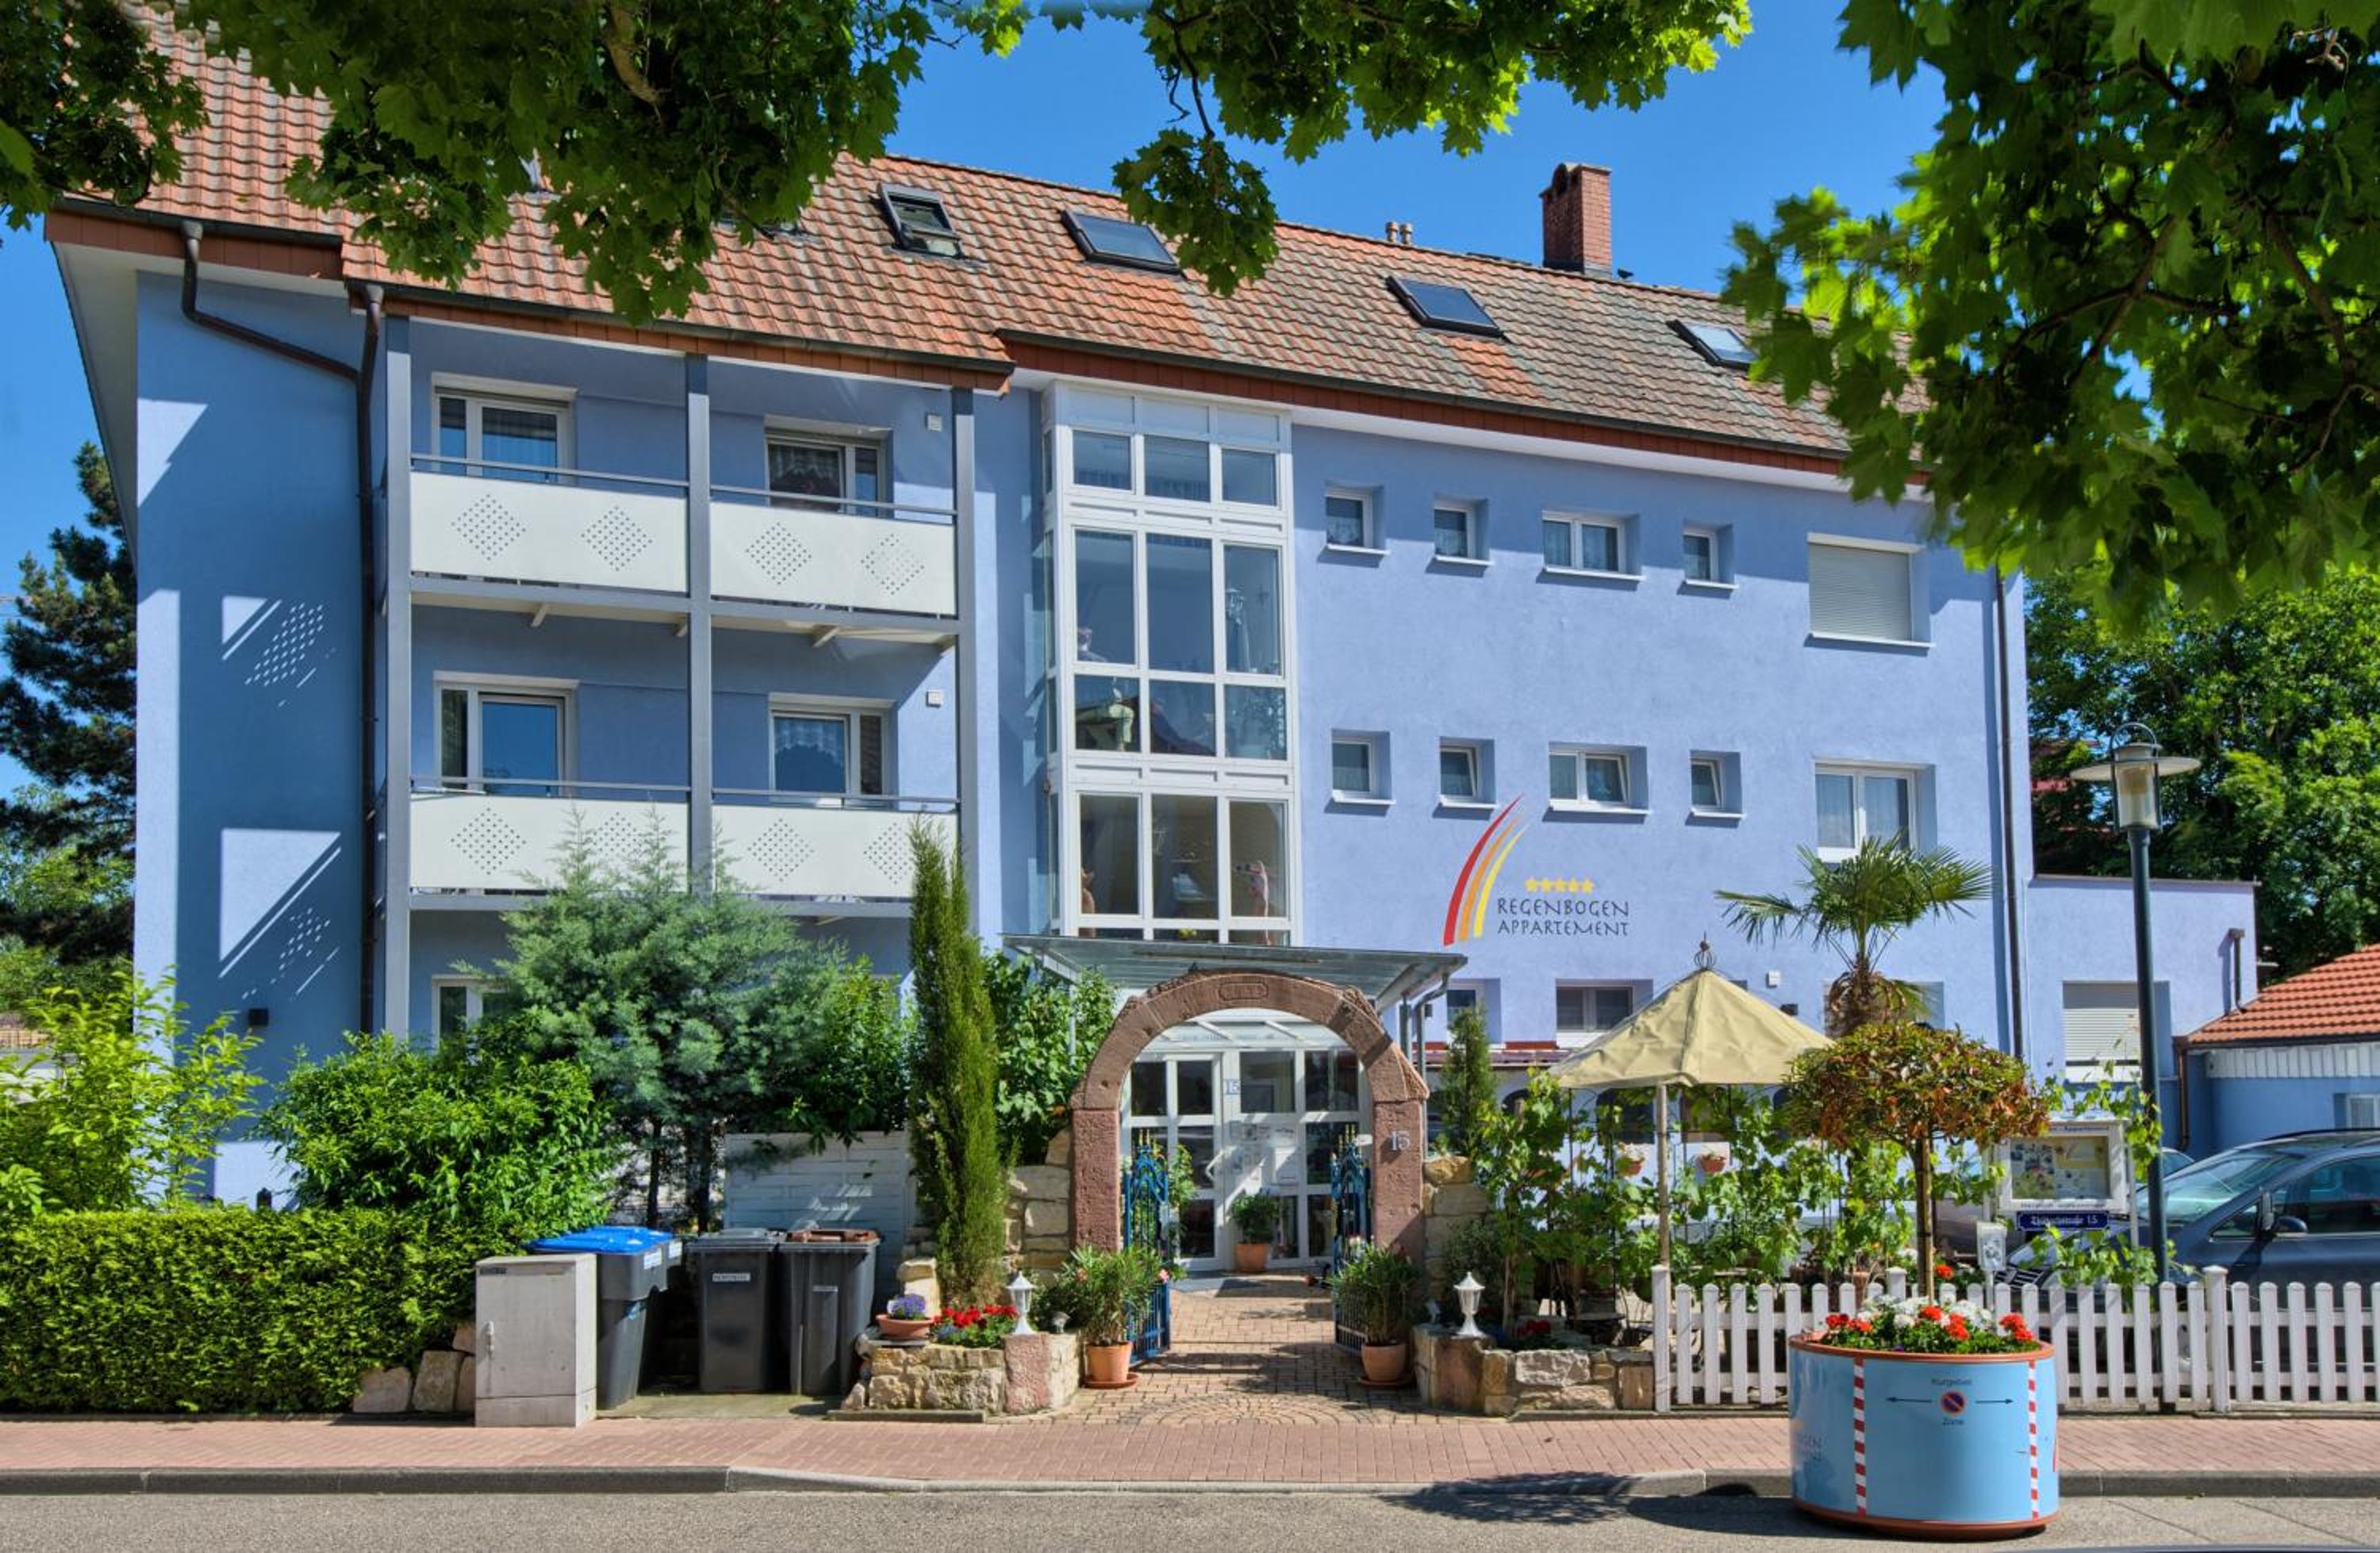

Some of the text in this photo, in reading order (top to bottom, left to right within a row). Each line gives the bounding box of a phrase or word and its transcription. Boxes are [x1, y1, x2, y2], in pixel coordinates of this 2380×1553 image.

[1497, 897, 1630, 917] REGENBOGEN
[1497, 919, 1630, 937] APPARTEMENT
[1390, 1130, 1410, 1150] 15
